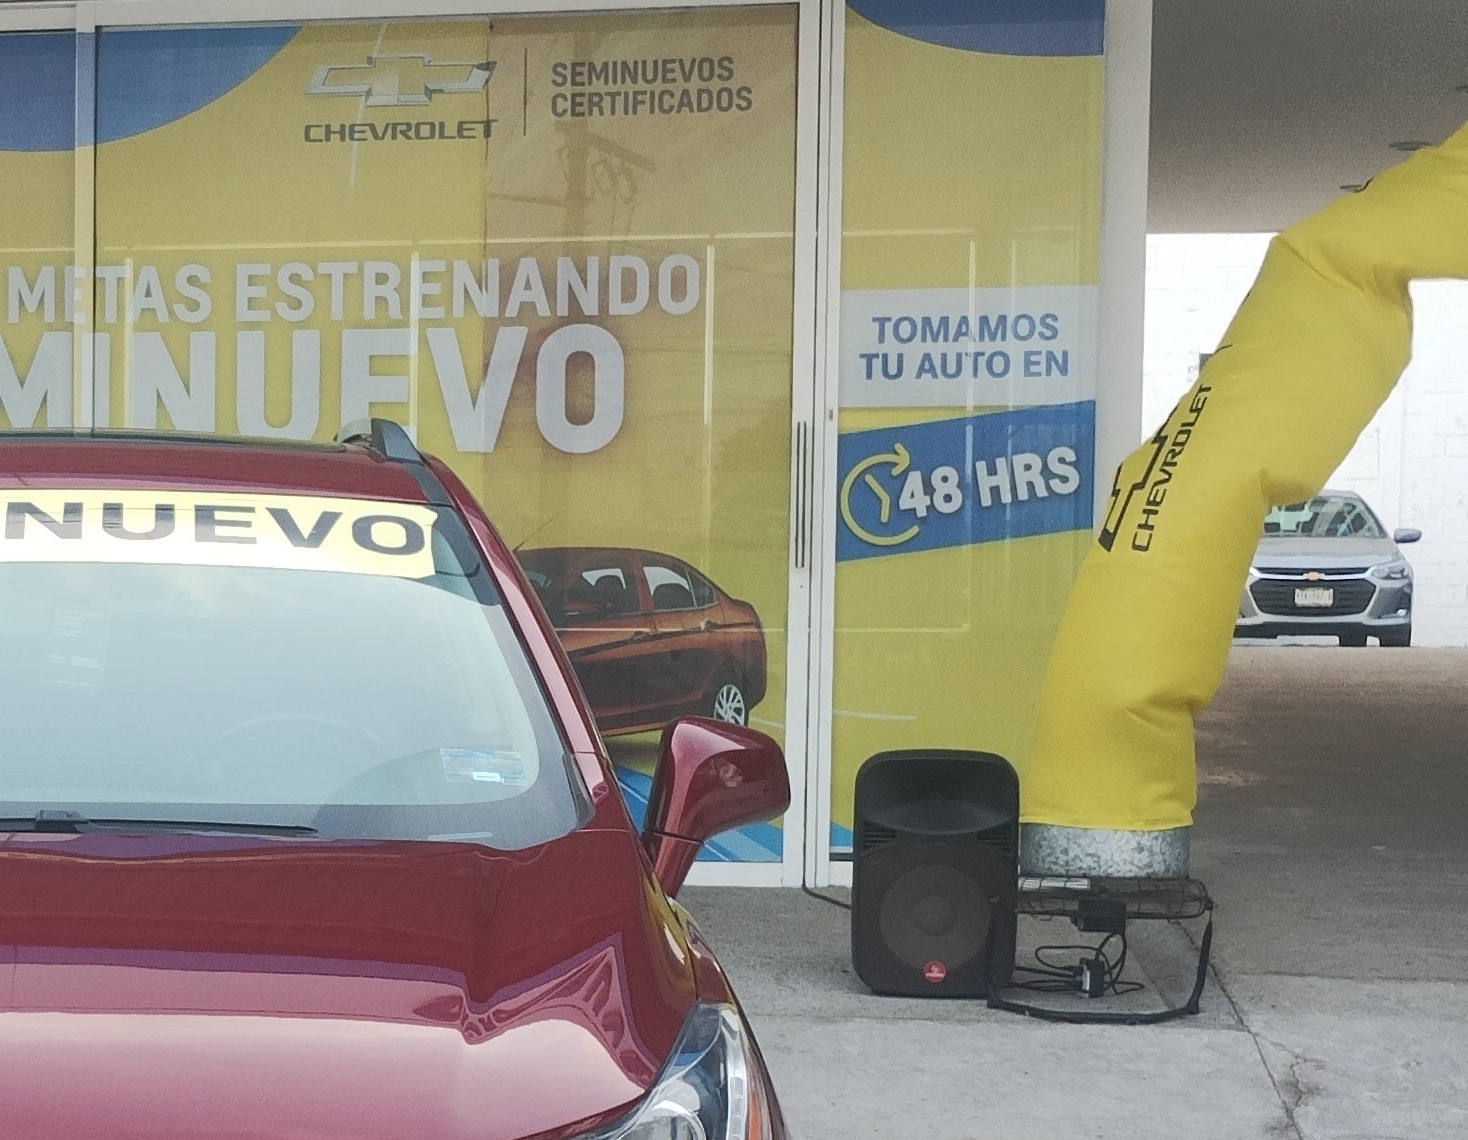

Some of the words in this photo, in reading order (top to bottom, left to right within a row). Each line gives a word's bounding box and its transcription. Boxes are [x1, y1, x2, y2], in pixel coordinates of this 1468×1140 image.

[551, 56, 735, 88] SEMINUEVOS
[551, 86, 754, 119] CERTIFICADOS
[303, 119, 498, 144] CHEVROLET
[7, 264, 213, 325] METAS
[235, 253, 701, 323] ESTRENANDO
[872, 313, 1060, 344] TOMAMOS
[859, 352, 904, 380] TU
[915, 350, 1011, 379] AUTO
[1023, 349, 1070, 377] EN
[898, 464, 963, 519] 48
[975, 446, 1081, 508] HRS
[1131, 383, 1213, 552] CHEVROLET
